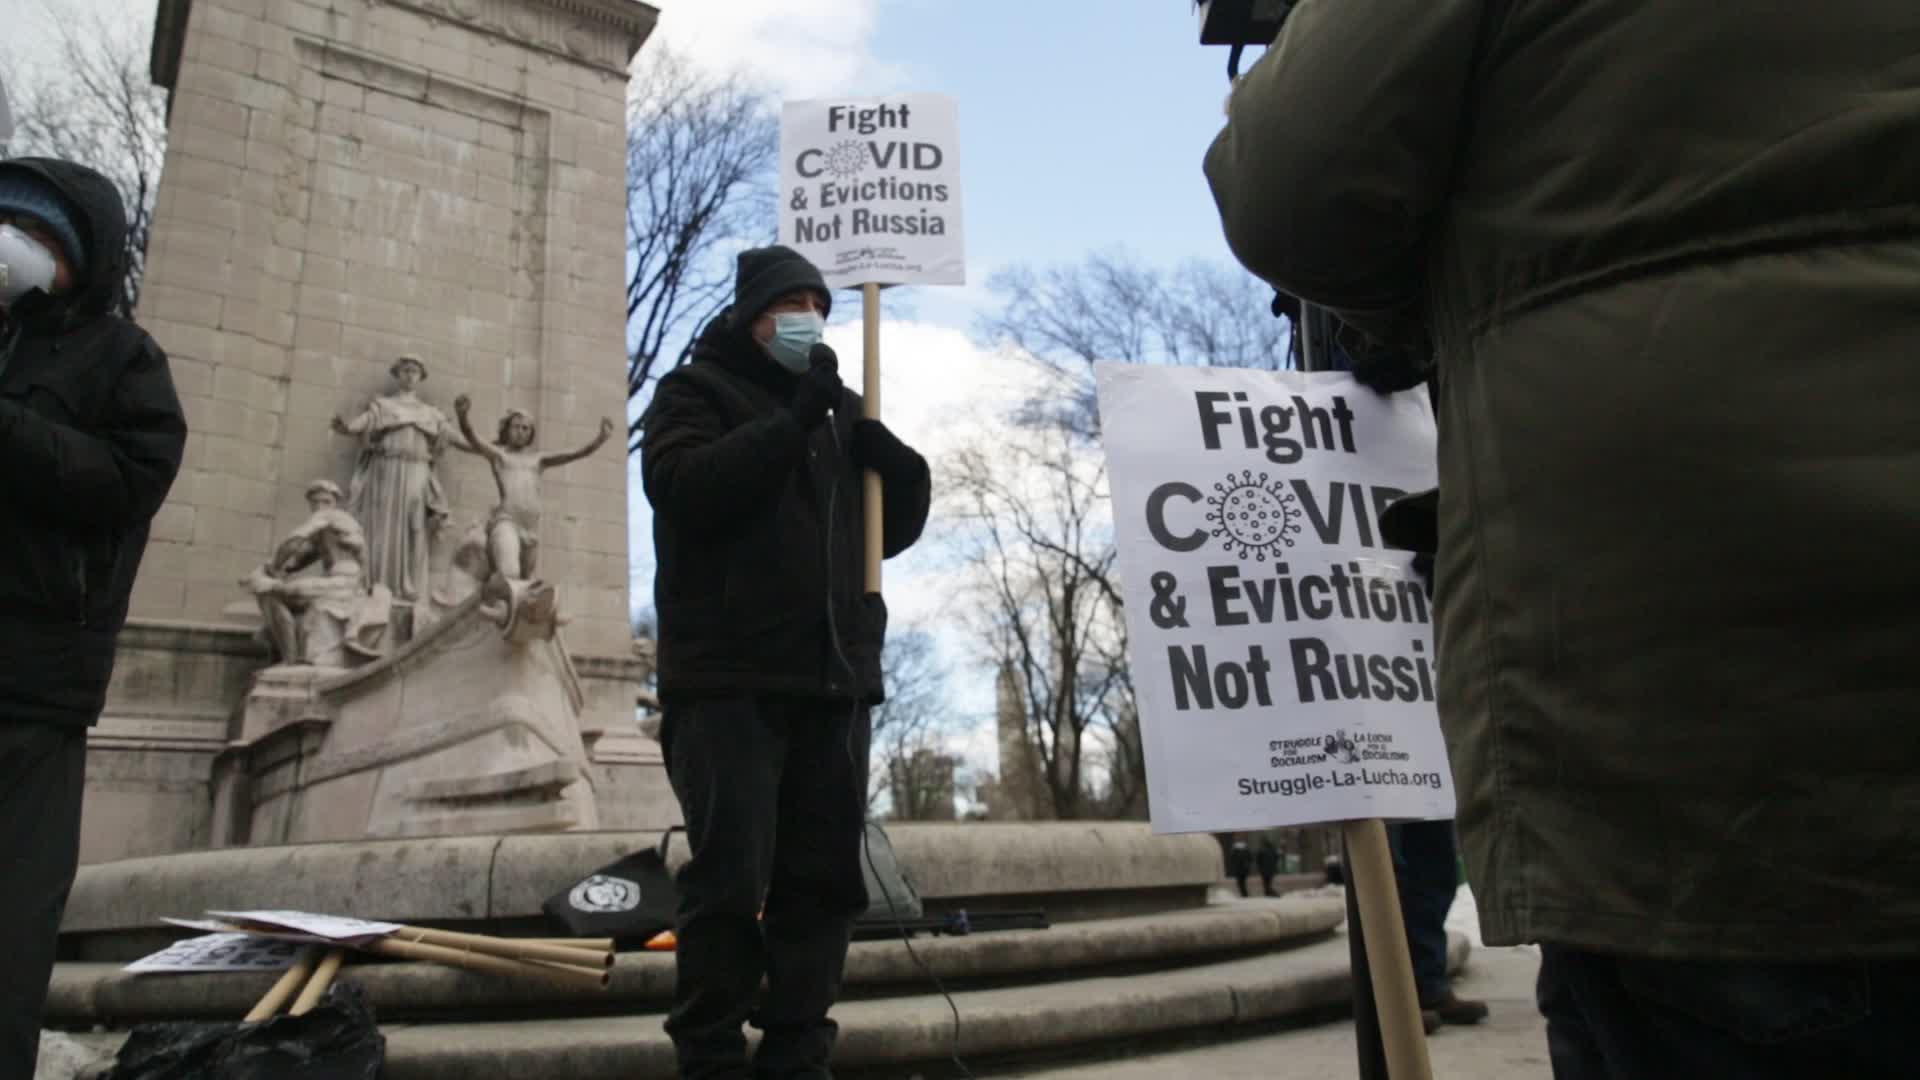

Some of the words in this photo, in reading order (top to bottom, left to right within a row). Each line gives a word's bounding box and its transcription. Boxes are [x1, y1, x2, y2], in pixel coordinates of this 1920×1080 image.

[828, 103, 910, 135] Fight
[795, 140, 942, 178] COVID
[790, 186, 808, 210] &
[820, 176, 948, 208] Evictions
[795, 214, 842, 242] Not
[853, 208, 945, 235] Russia
[1195, 391, 1357, 464] Fight
[1149, 571, 1191, 629] &
[1207, 562, 1430, 626] Eviction
[1167, 645, 1273, 711] Not
[1289, 637, 1435, 704] Russi
[1270, 736, 1322, 750] STRUGGLE
[1271, 753, 1327, 768] SOCIALISM
[1238, 768, 1442, 796] Struggle-La-Lucha.org
